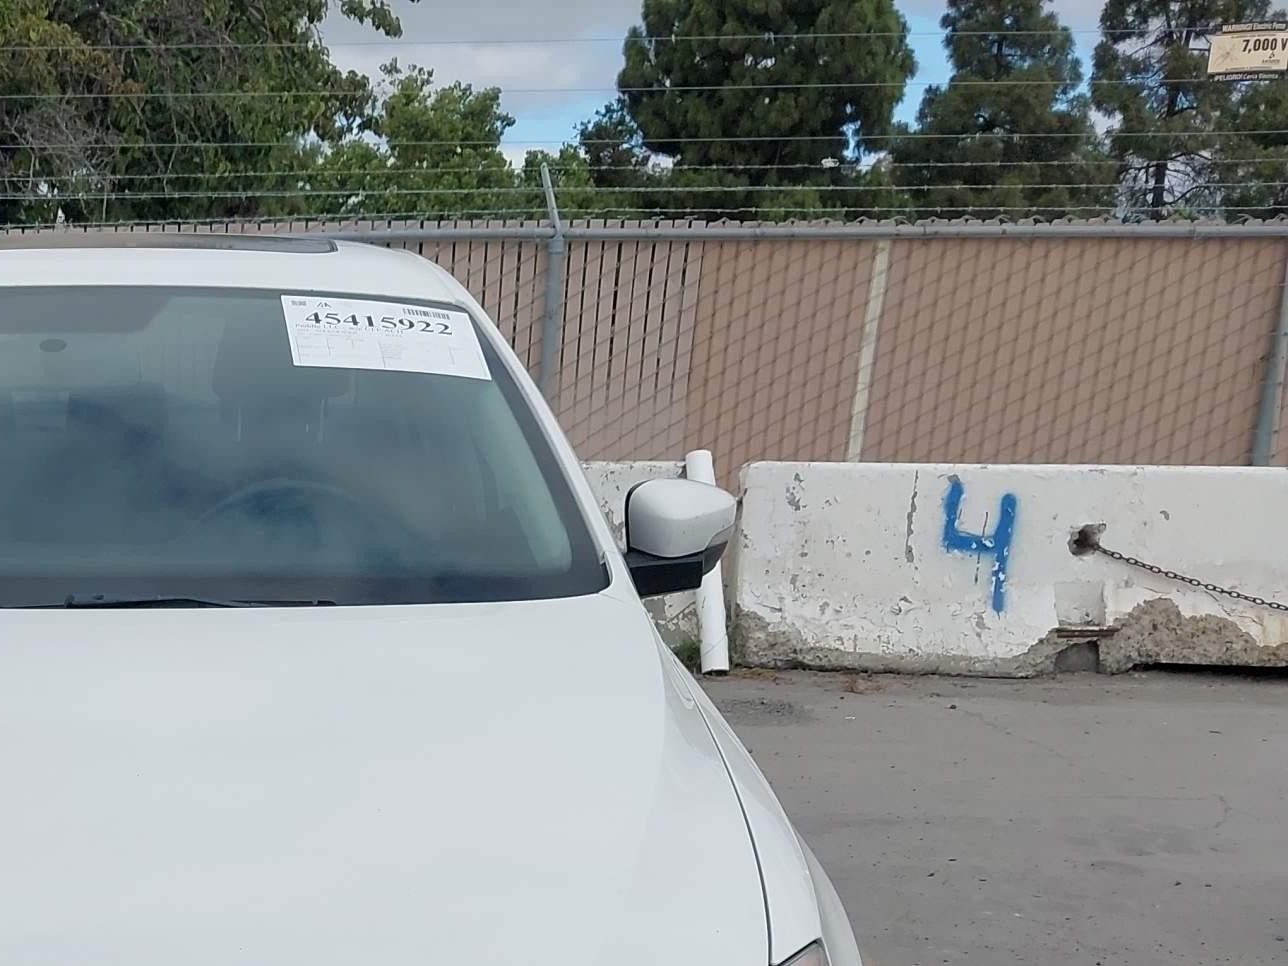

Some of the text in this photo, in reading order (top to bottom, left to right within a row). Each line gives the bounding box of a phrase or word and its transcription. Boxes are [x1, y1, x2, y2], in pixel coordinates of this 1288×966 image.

[1242, 38, 1288, 53] 7,000 V
[305, 311, 453, 336] 45415922
[941, 474, 1017, 612] 4
